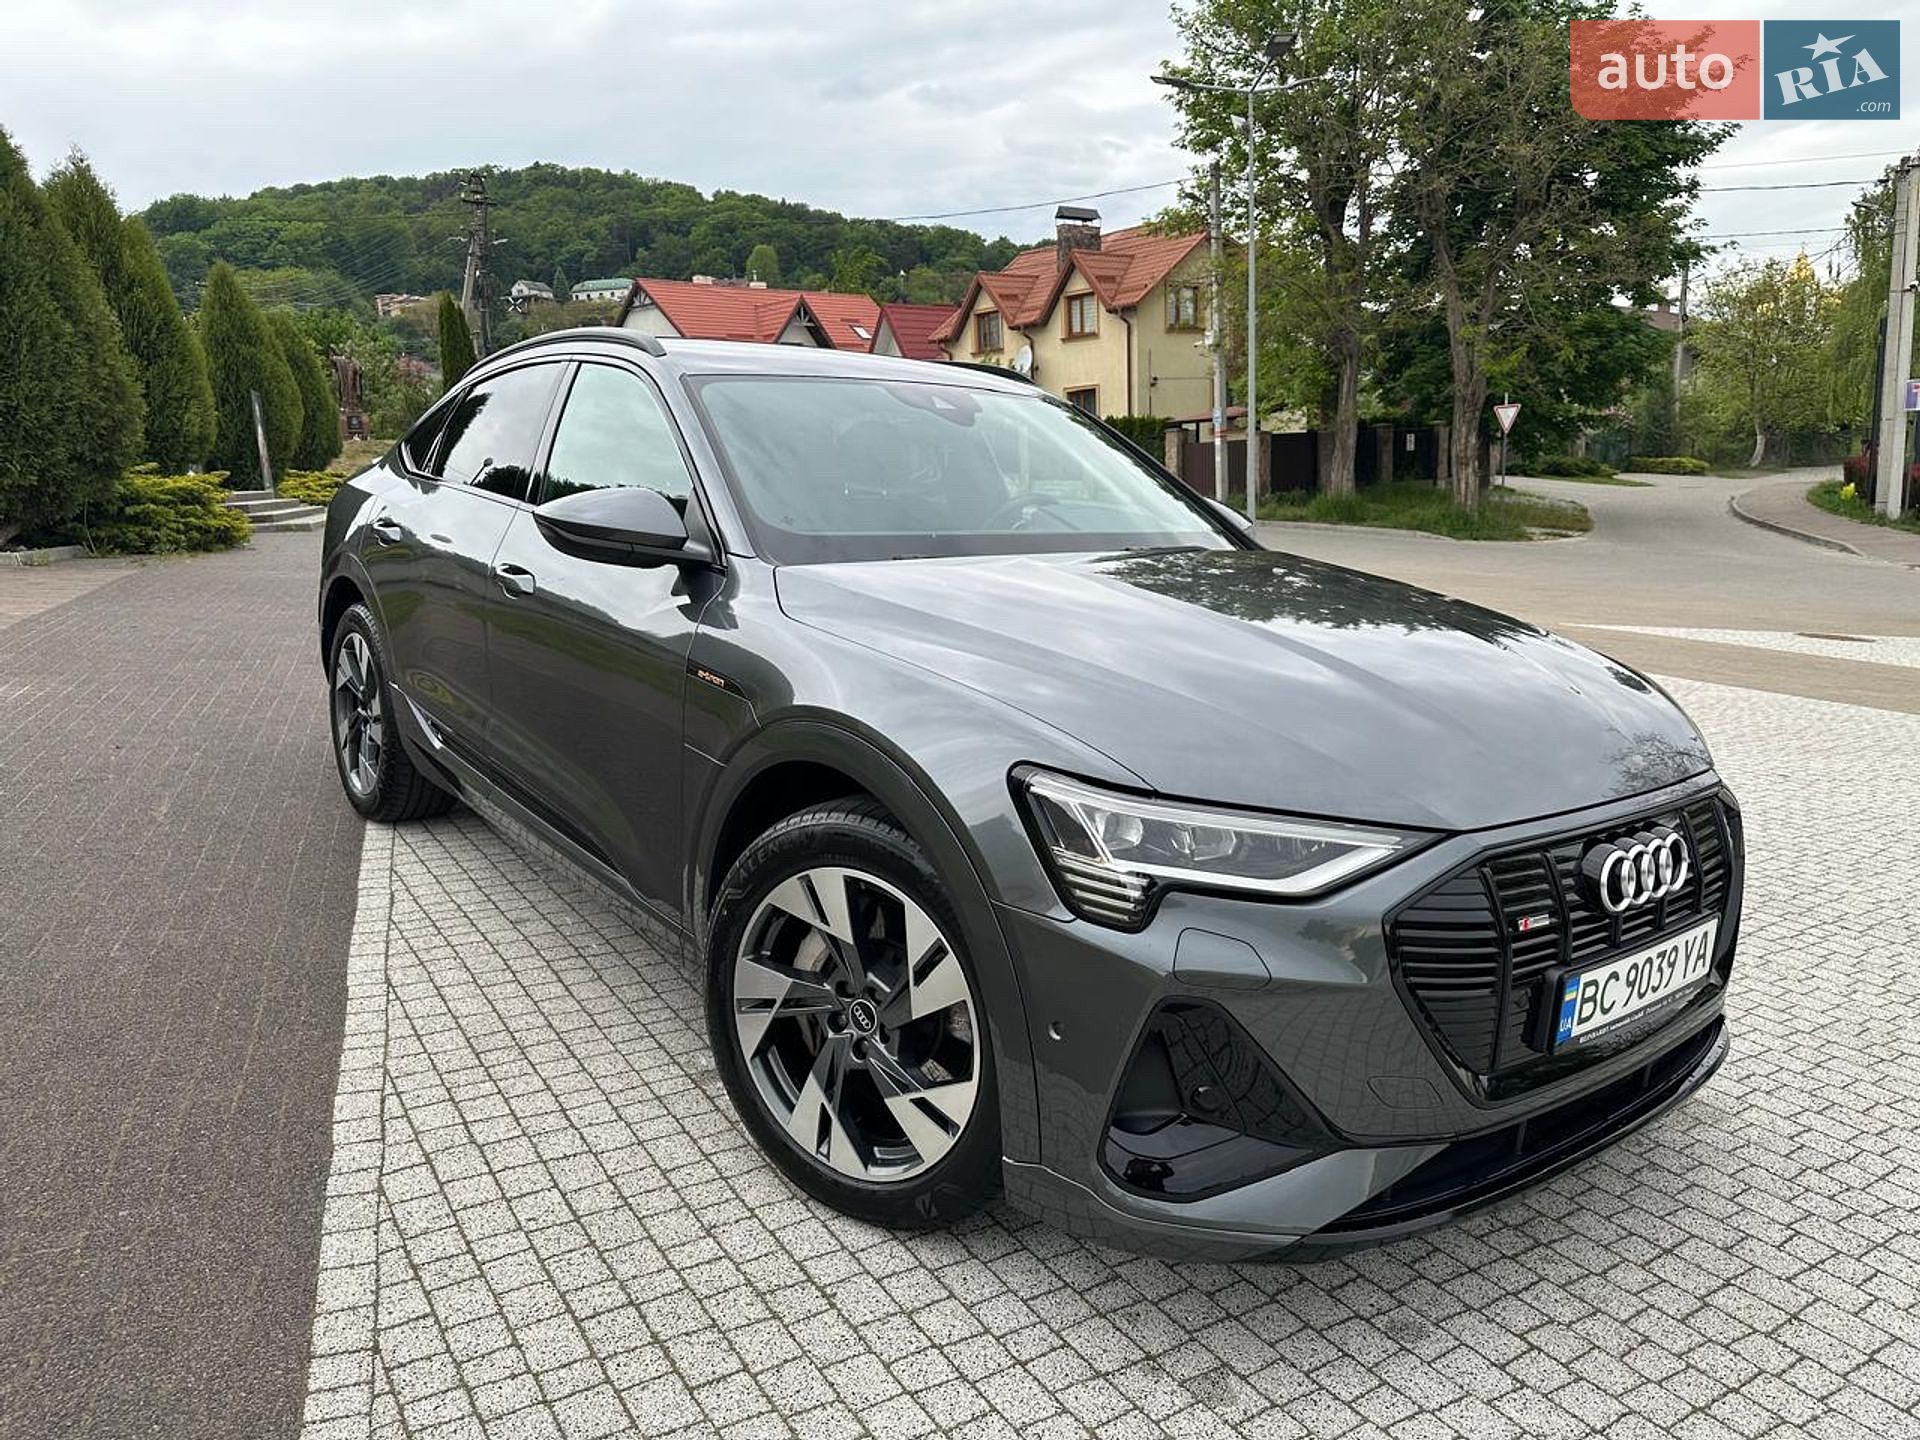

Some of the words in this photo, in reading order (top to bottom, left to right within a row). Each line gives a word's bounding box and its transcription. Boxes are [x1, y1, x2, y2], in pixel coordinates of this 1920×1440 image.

[1576, 970, 1620, 1026] BC
[1623, 945, 1679, 1007] 9039
[1683, 930, 1708, 979] YA
[1560, 1016, 1571, 1032] UA
